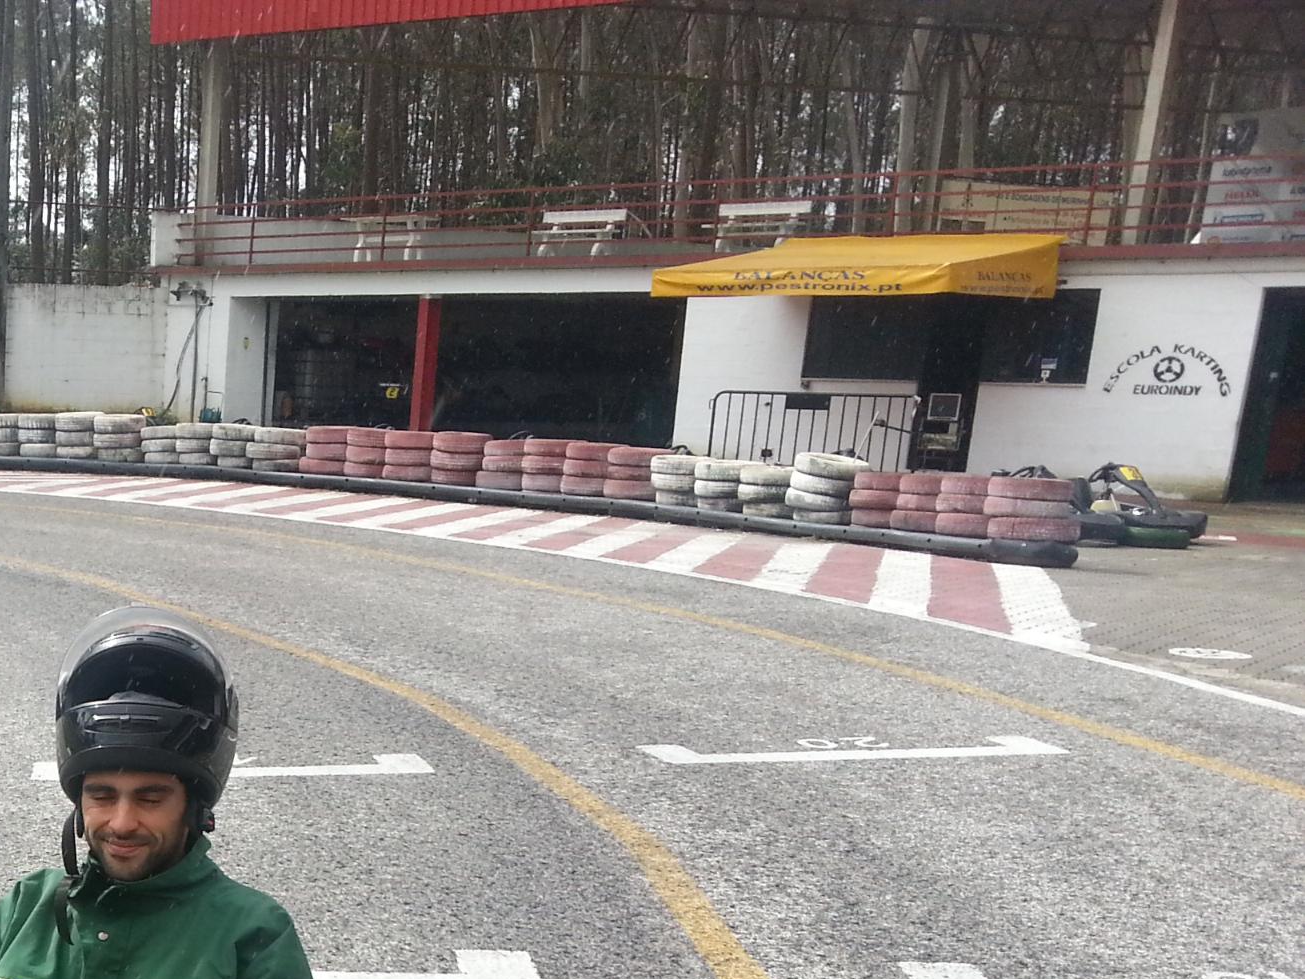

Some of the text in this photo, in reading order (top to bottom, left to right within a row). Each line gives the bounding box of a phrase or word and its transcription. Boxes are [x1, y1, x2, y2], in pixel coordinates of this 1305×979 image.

[696, 281, 903, 293] www.pestronix.pt
[1102, 343, 1231, 398] ESCOLA KARTING
[1132, 384, 1202, 396] EUROINDY
